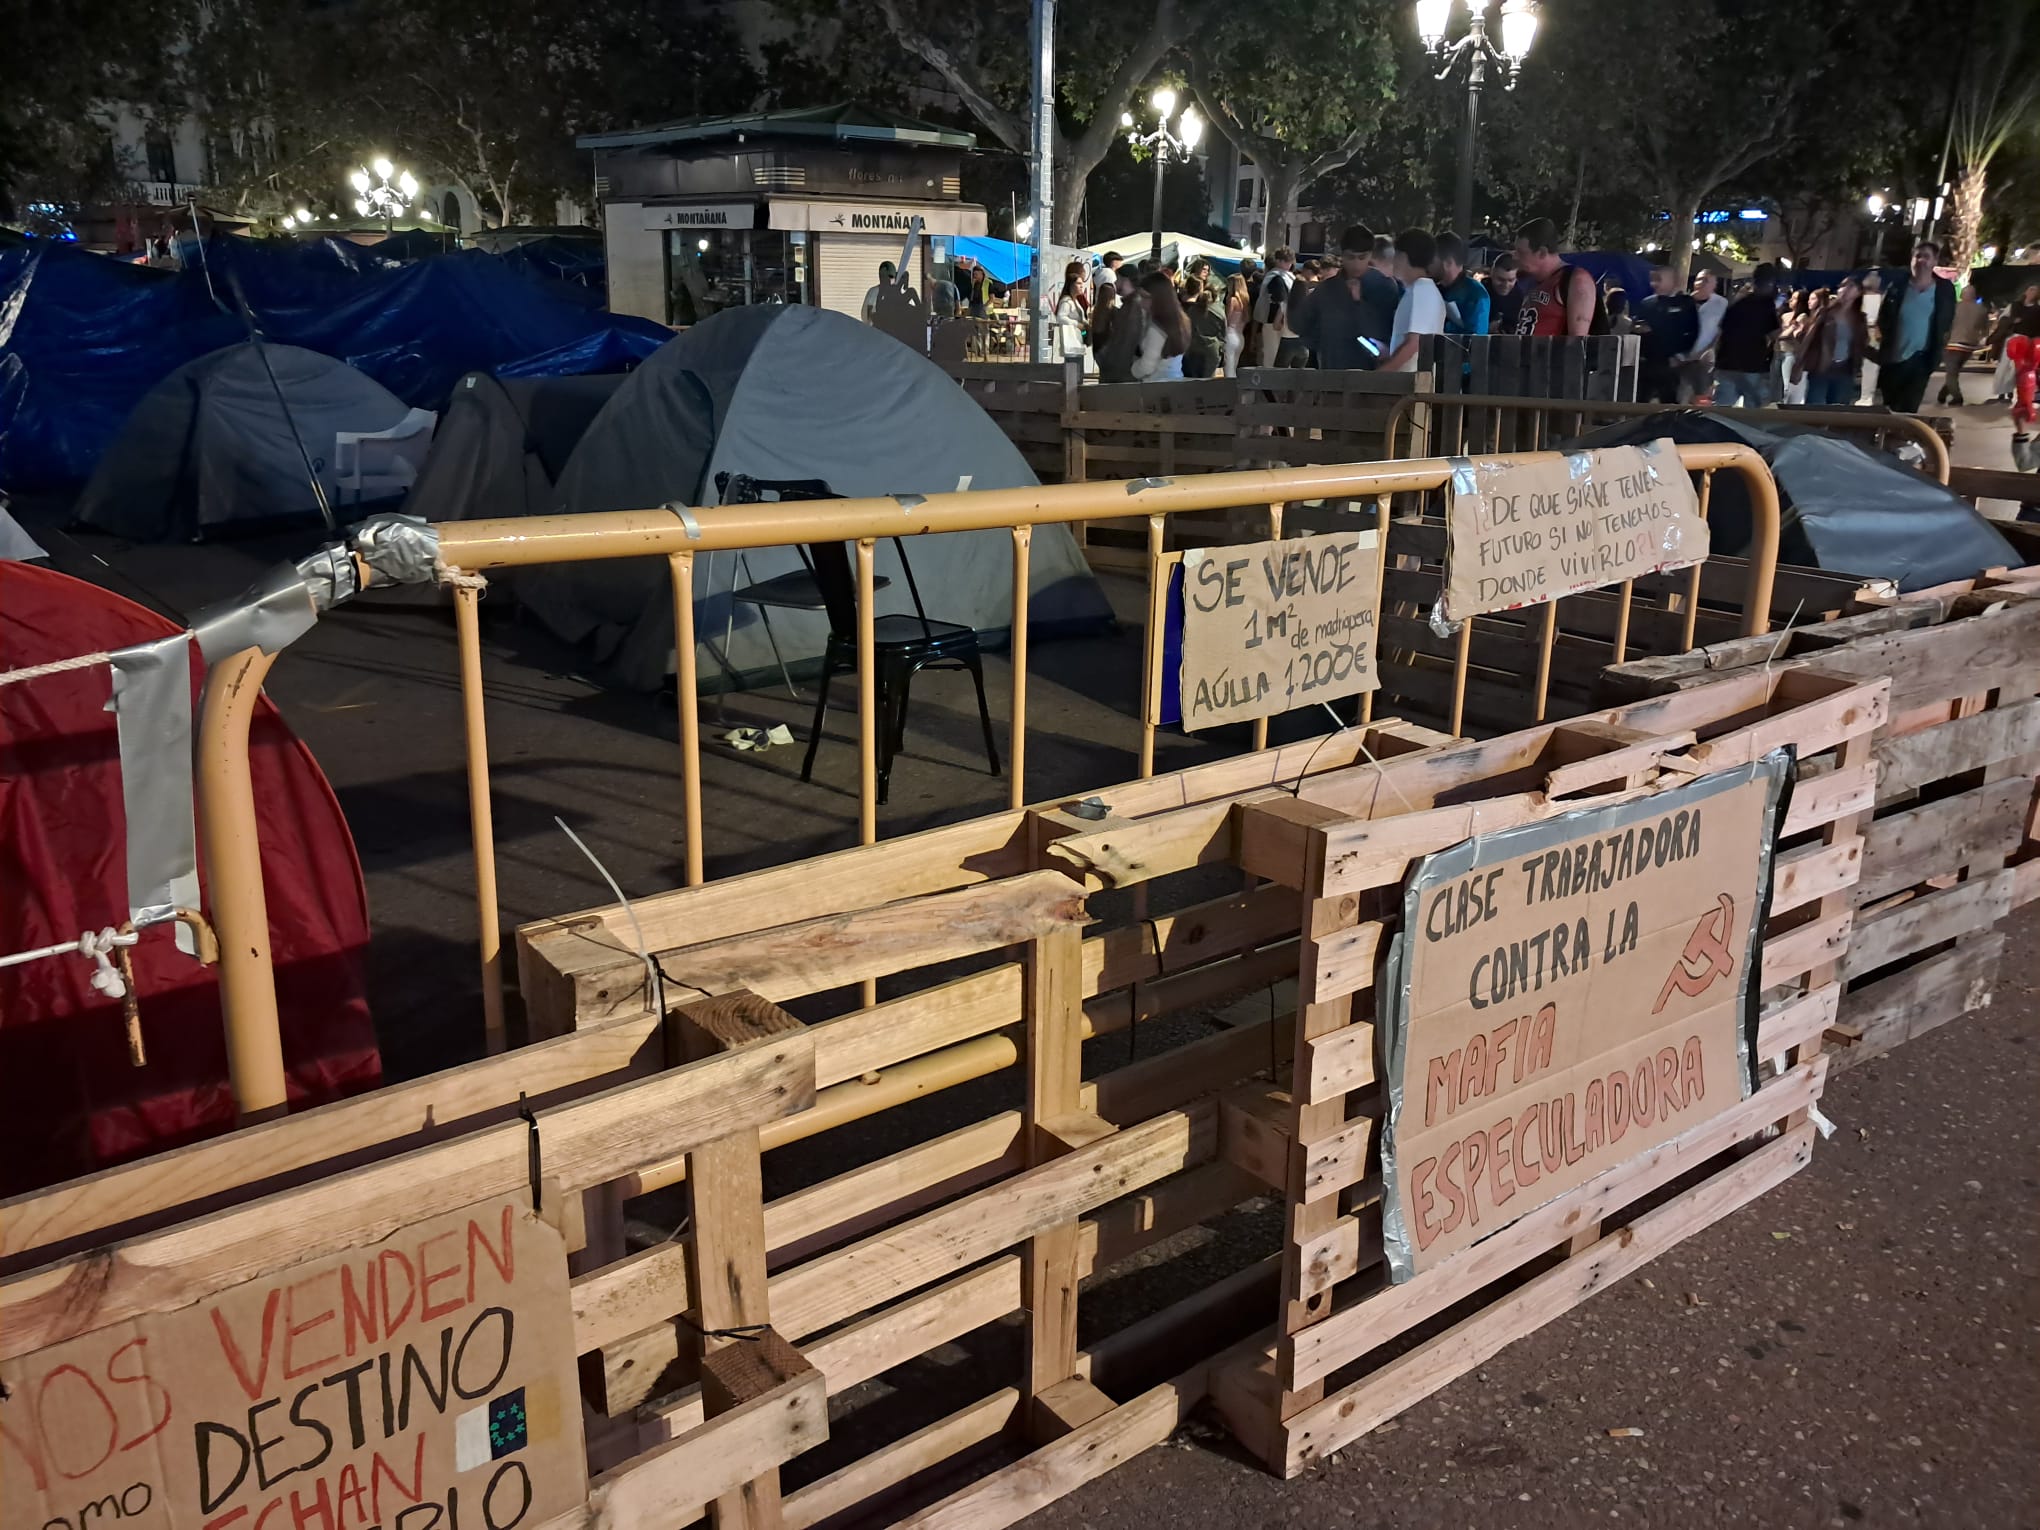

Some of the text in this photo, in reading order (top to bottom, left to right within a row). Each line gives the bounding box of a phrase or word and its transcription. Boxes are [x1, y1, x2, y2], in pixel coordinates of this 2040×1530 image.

[677, 208, 727, 225] MONTAÑANA
[1480, 499, 1673, 567] FUTURO SI NO TENEMOS
[1529, 493, 1562, 519] QUE
[1192, 542, 1360, 612] SE VENDE
[1477, 566, 1547, 602] DONDE
[1290, 618, 1309, 650] de
[1425, 808, 1702, 943] CLASE TRABAJADORA
[1469, 901, 1639, 1010] CONTRA LA
[1425, 1002, 1556, 1128] MAFIA
[1410, 1035, 1705, 1251] ESPECULADORA
[210, 1204, 516, 1401] VENDEN
[193, 1305, 516, 1517] DESTINO
